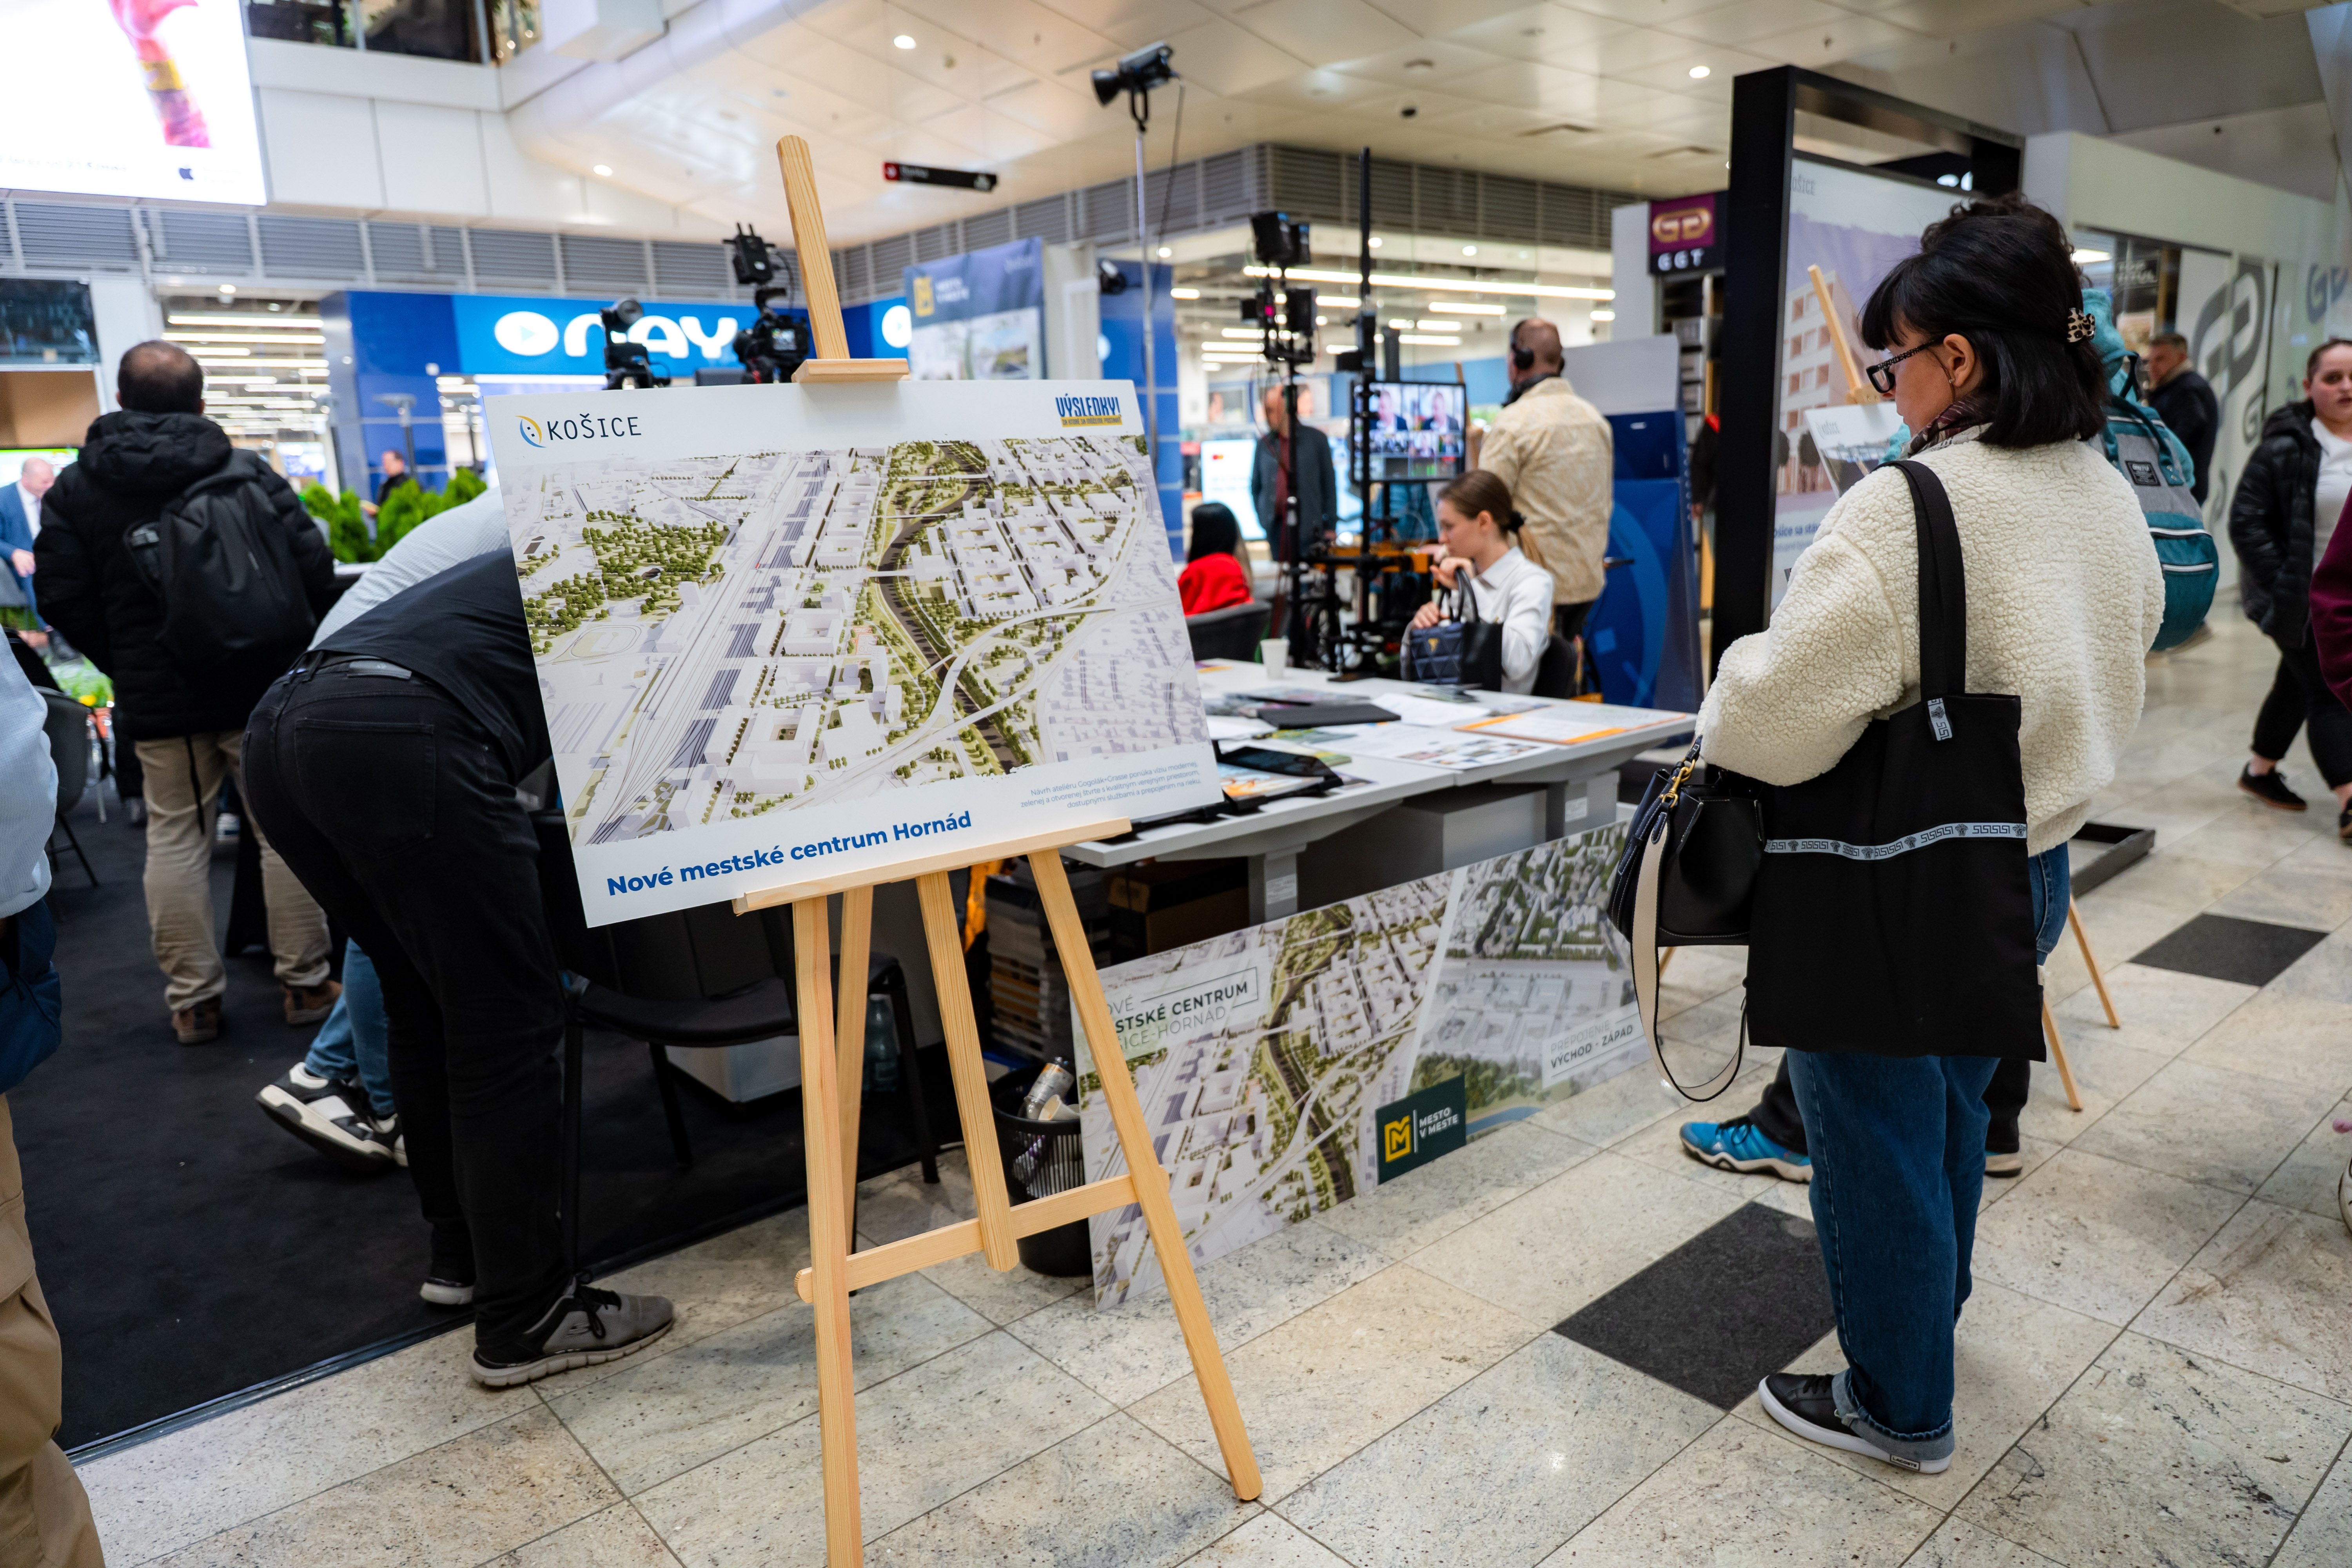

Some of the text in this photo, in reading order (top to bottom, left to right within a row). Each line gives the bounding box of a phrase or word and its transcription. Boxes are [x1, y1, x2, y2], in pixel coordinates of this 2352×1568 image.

[1792, 174, 1815, 196] OŠICE
[1055, 393, 1121, 417] VÝSLEDKY!
[547, 413, 642, 441] KOŠICE
[1021, 798, 1044, 808] zelenej
[1051, 791, 1082, 802] otvorenej
[1082, 787, 1100, 796] štvrte
[1106, 780, 1136, 791] kvalitným
[1138, 776, 1165, 786] verejným
[1167, 770, 1200, 781] priestorom,
[1031, 786, 1051, 796] Návrh
[1052, 783, 1076, 792] ateliéru
[1078, 774, 1128, 788] Gogolák+Grasse
[1129, 769, 1152, 779] ponúka
[1168, 762, 1198, 771] modernej,
[1067, 797, 1105, 808] dostupnými
[1107, 790, 1135, 800] službami
[1141, 783, 1176, 796] prepojením
[607, 810, 972, 897] Nové mestské centrum Hornád
[1115, 981, 1247, 1033] STSKÉ CENTRUM
[1551, 1019, 1610, 1053] PREPOJENIE
[1551, 1042, 1592, 1069] VÝCHOD
[1602, 1024, 1633, 1047] ZÁPAD
[1419, 1107, 1452, 1128] MESTO
[1419, 1113, 1459, 1139] V MESTE
